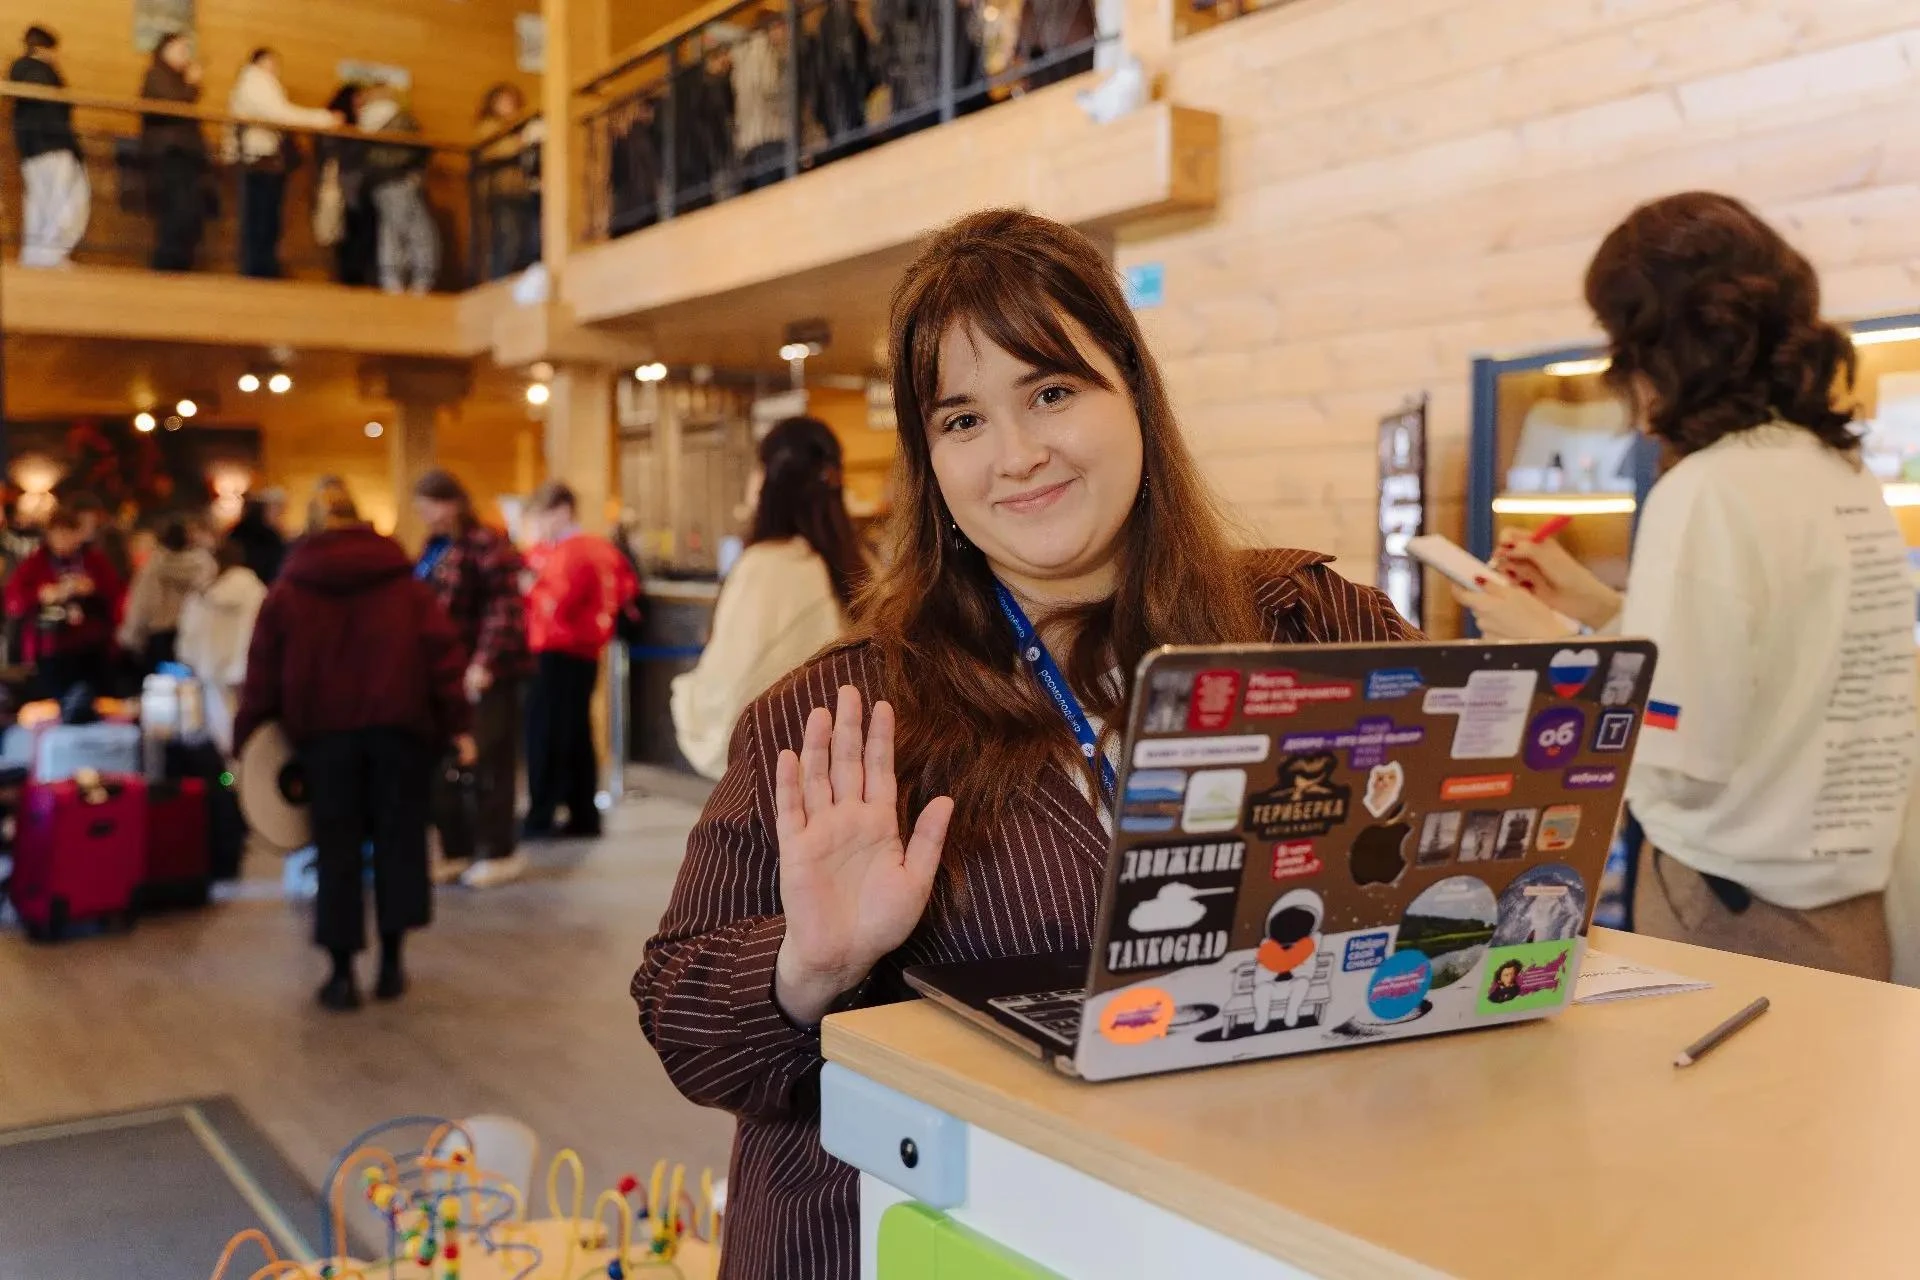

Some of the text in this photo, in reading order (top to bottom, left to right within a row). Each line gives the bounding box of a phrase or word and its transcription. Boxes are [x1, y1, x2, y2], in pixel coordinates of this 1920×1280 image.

[1252, 798, 1344, 825] ТЕРИБЕРКА
[1120, 841, 1246, 883] ДВИЖЕНИЕ
[1108, 930, 1229, 970] TANKOGRAD
